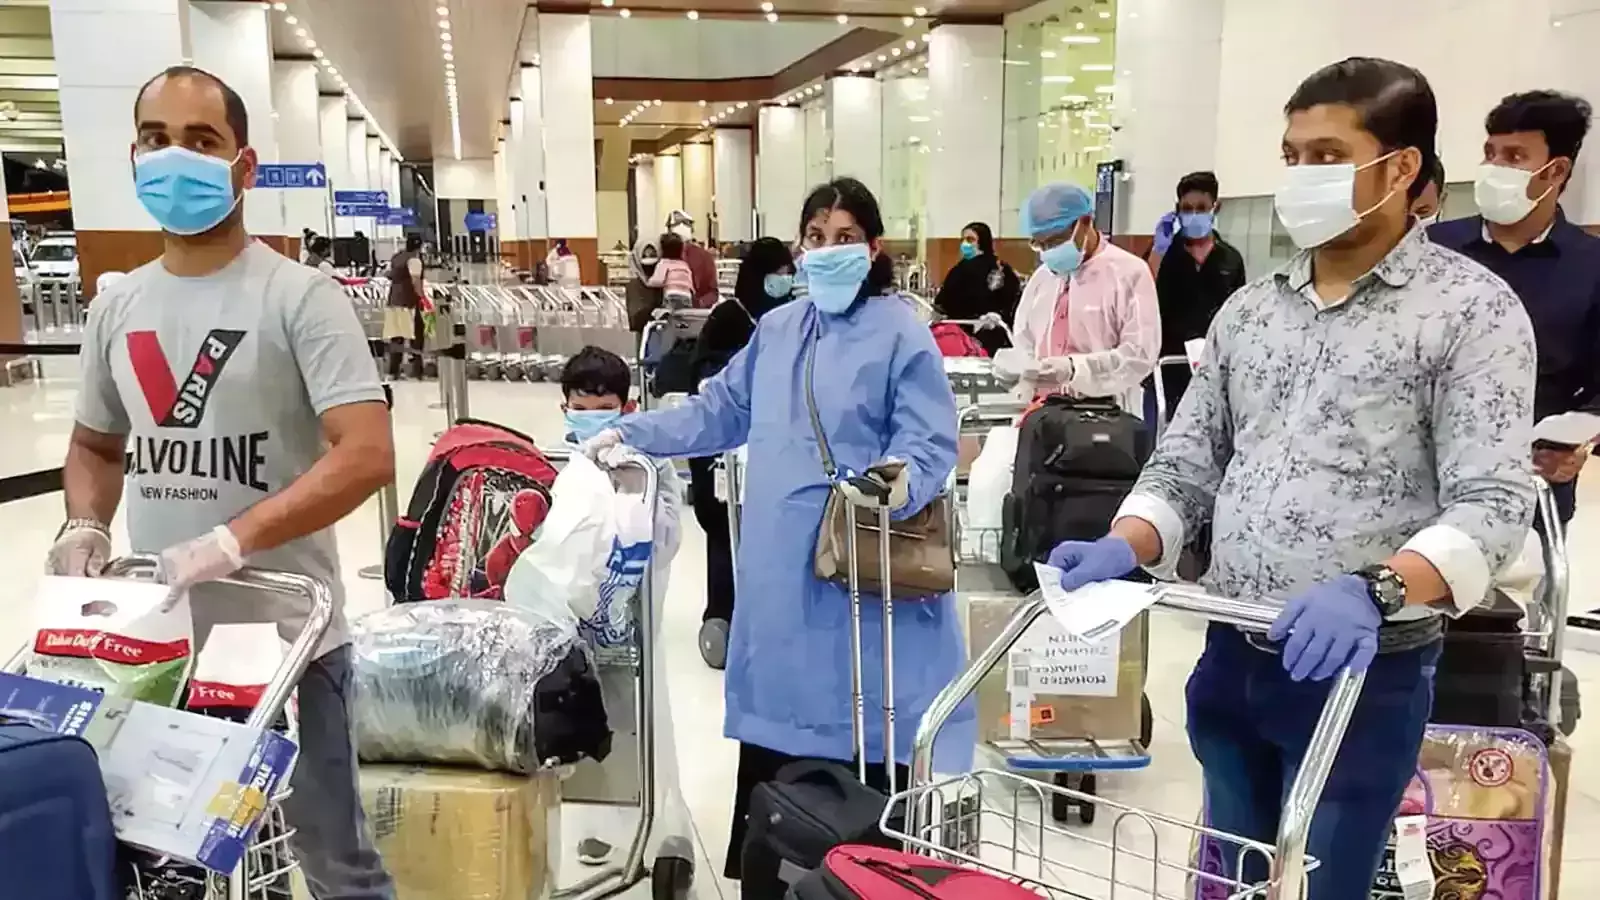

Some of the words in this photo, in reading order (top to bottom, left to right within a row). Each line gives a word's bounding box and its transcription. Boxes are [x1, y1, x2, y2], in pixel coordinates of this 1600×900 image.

[173, 336, 228, 425] PARIS
[165, 486, 218, 500] FASHION
[103, 638, 142, 657] Free
[198, 686, 235, 701] Free
